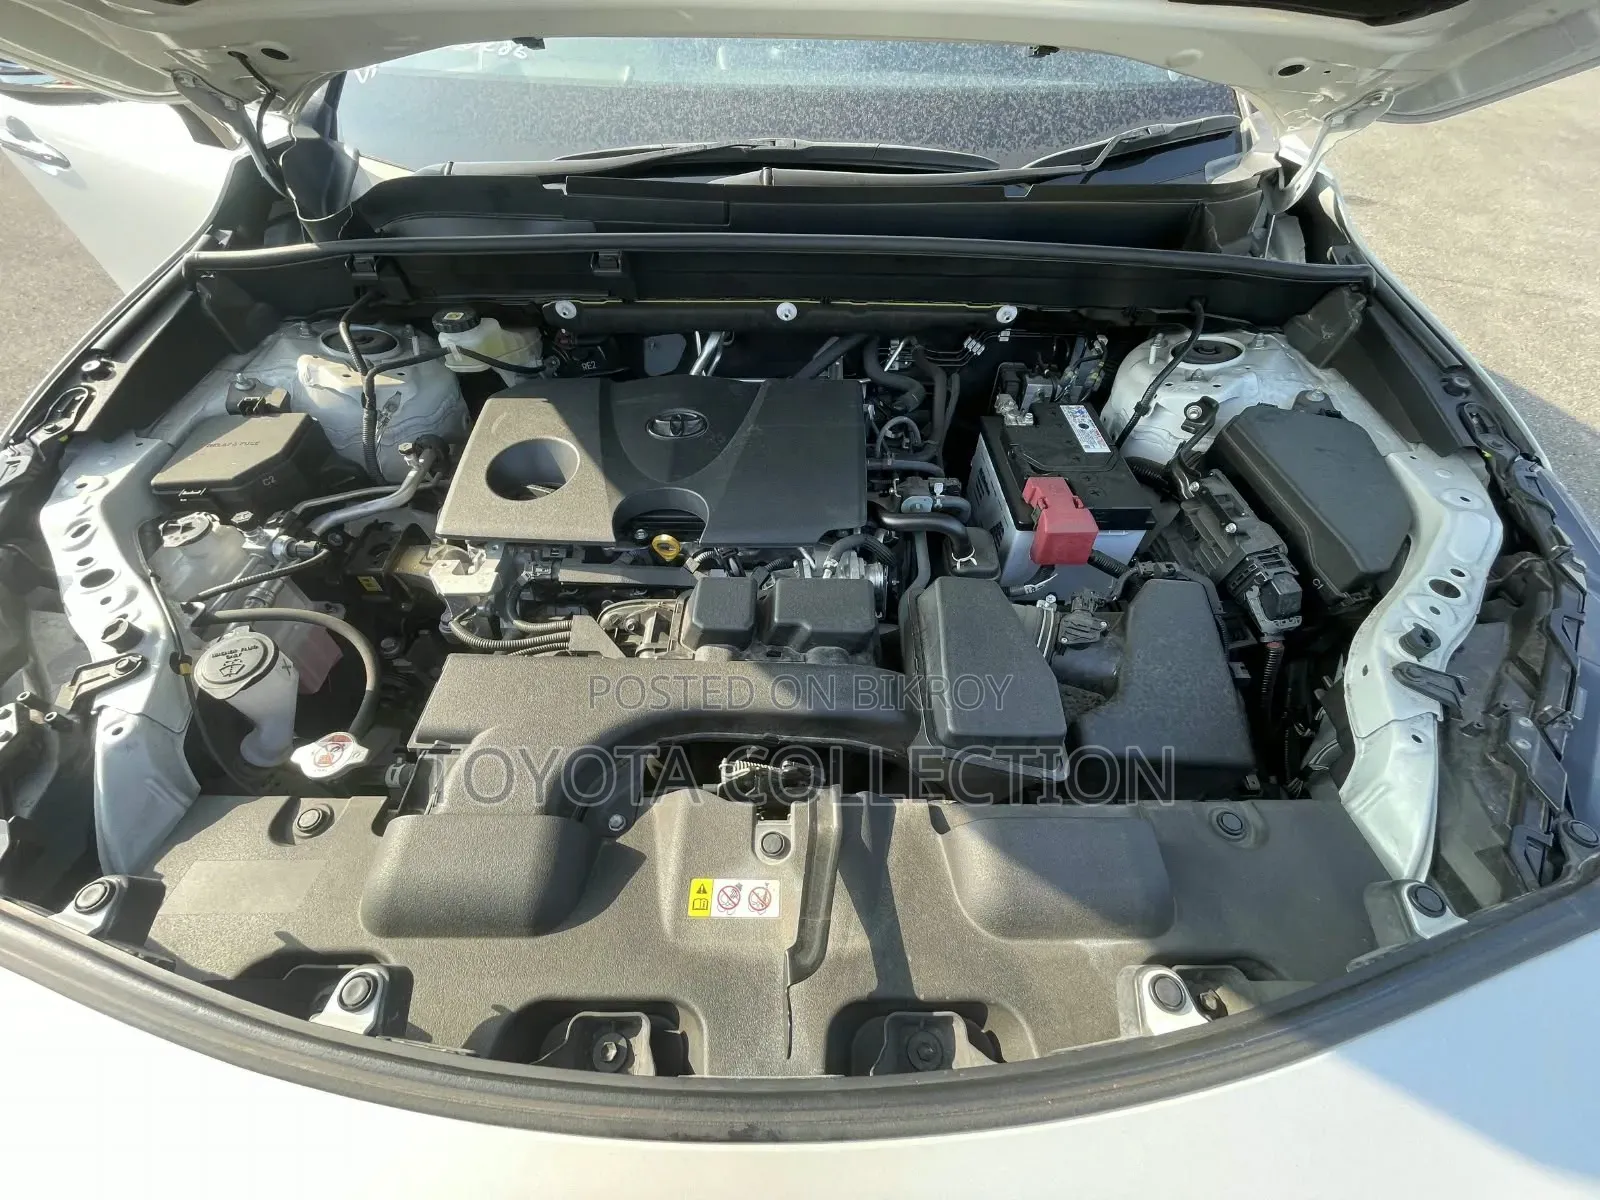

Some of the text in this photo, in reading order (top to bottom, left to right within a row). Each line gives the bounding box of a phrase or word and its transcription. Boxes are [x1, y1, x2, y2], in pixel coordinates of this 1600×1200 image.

[581, 360, 597, 370] RE2
[262, 475, 276, 486] C2
[1312, 578, 1324, 590] C1
